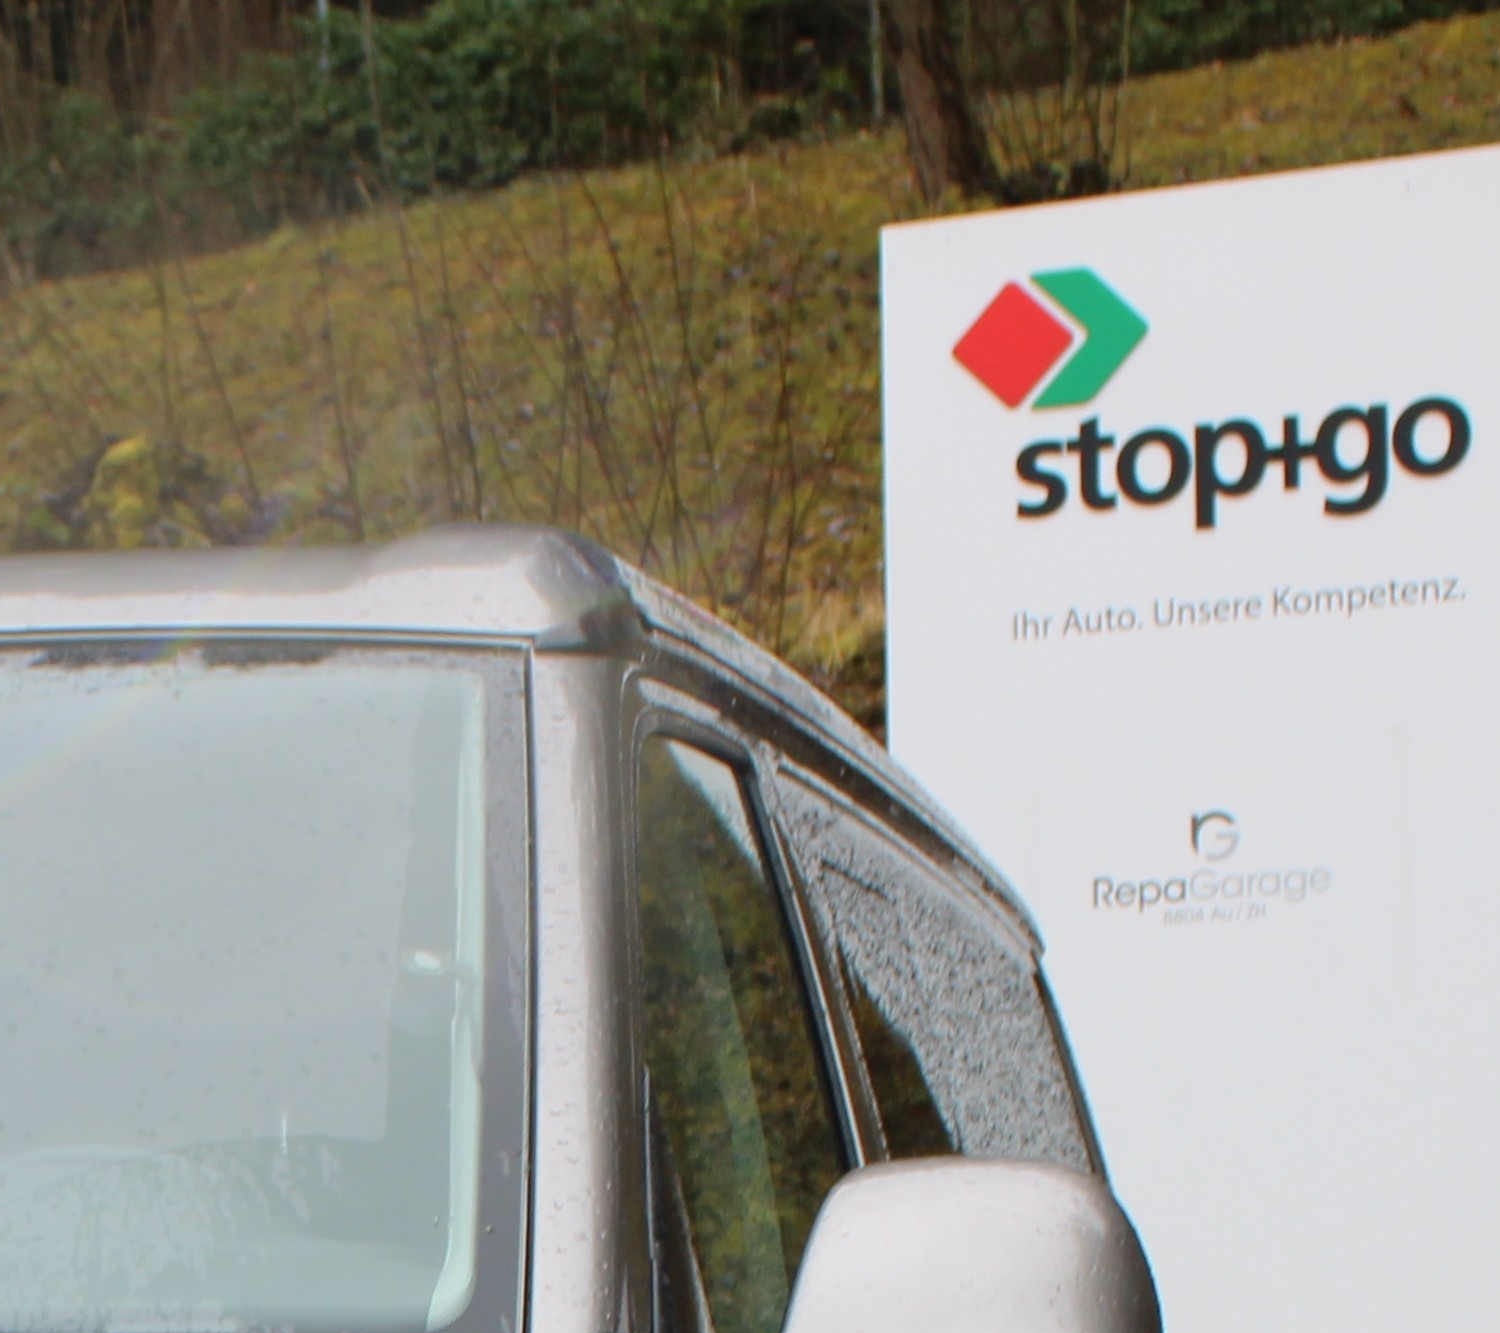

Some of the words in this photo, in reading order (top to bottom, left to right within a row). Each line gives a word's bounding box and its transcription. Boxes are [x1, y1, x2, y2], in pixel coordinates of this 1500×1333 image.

[1015, 393, 1473, 533] stop+go
[1012, 610, 1052, 641] Ihr
[1062, 605, 1143, 637] Auto.
[1153, 596, 1262, 628] Unsere
[1272, 576, 1466, 619] Kompetenz.
[1091, 865, 1333, 913] RepaGarage
